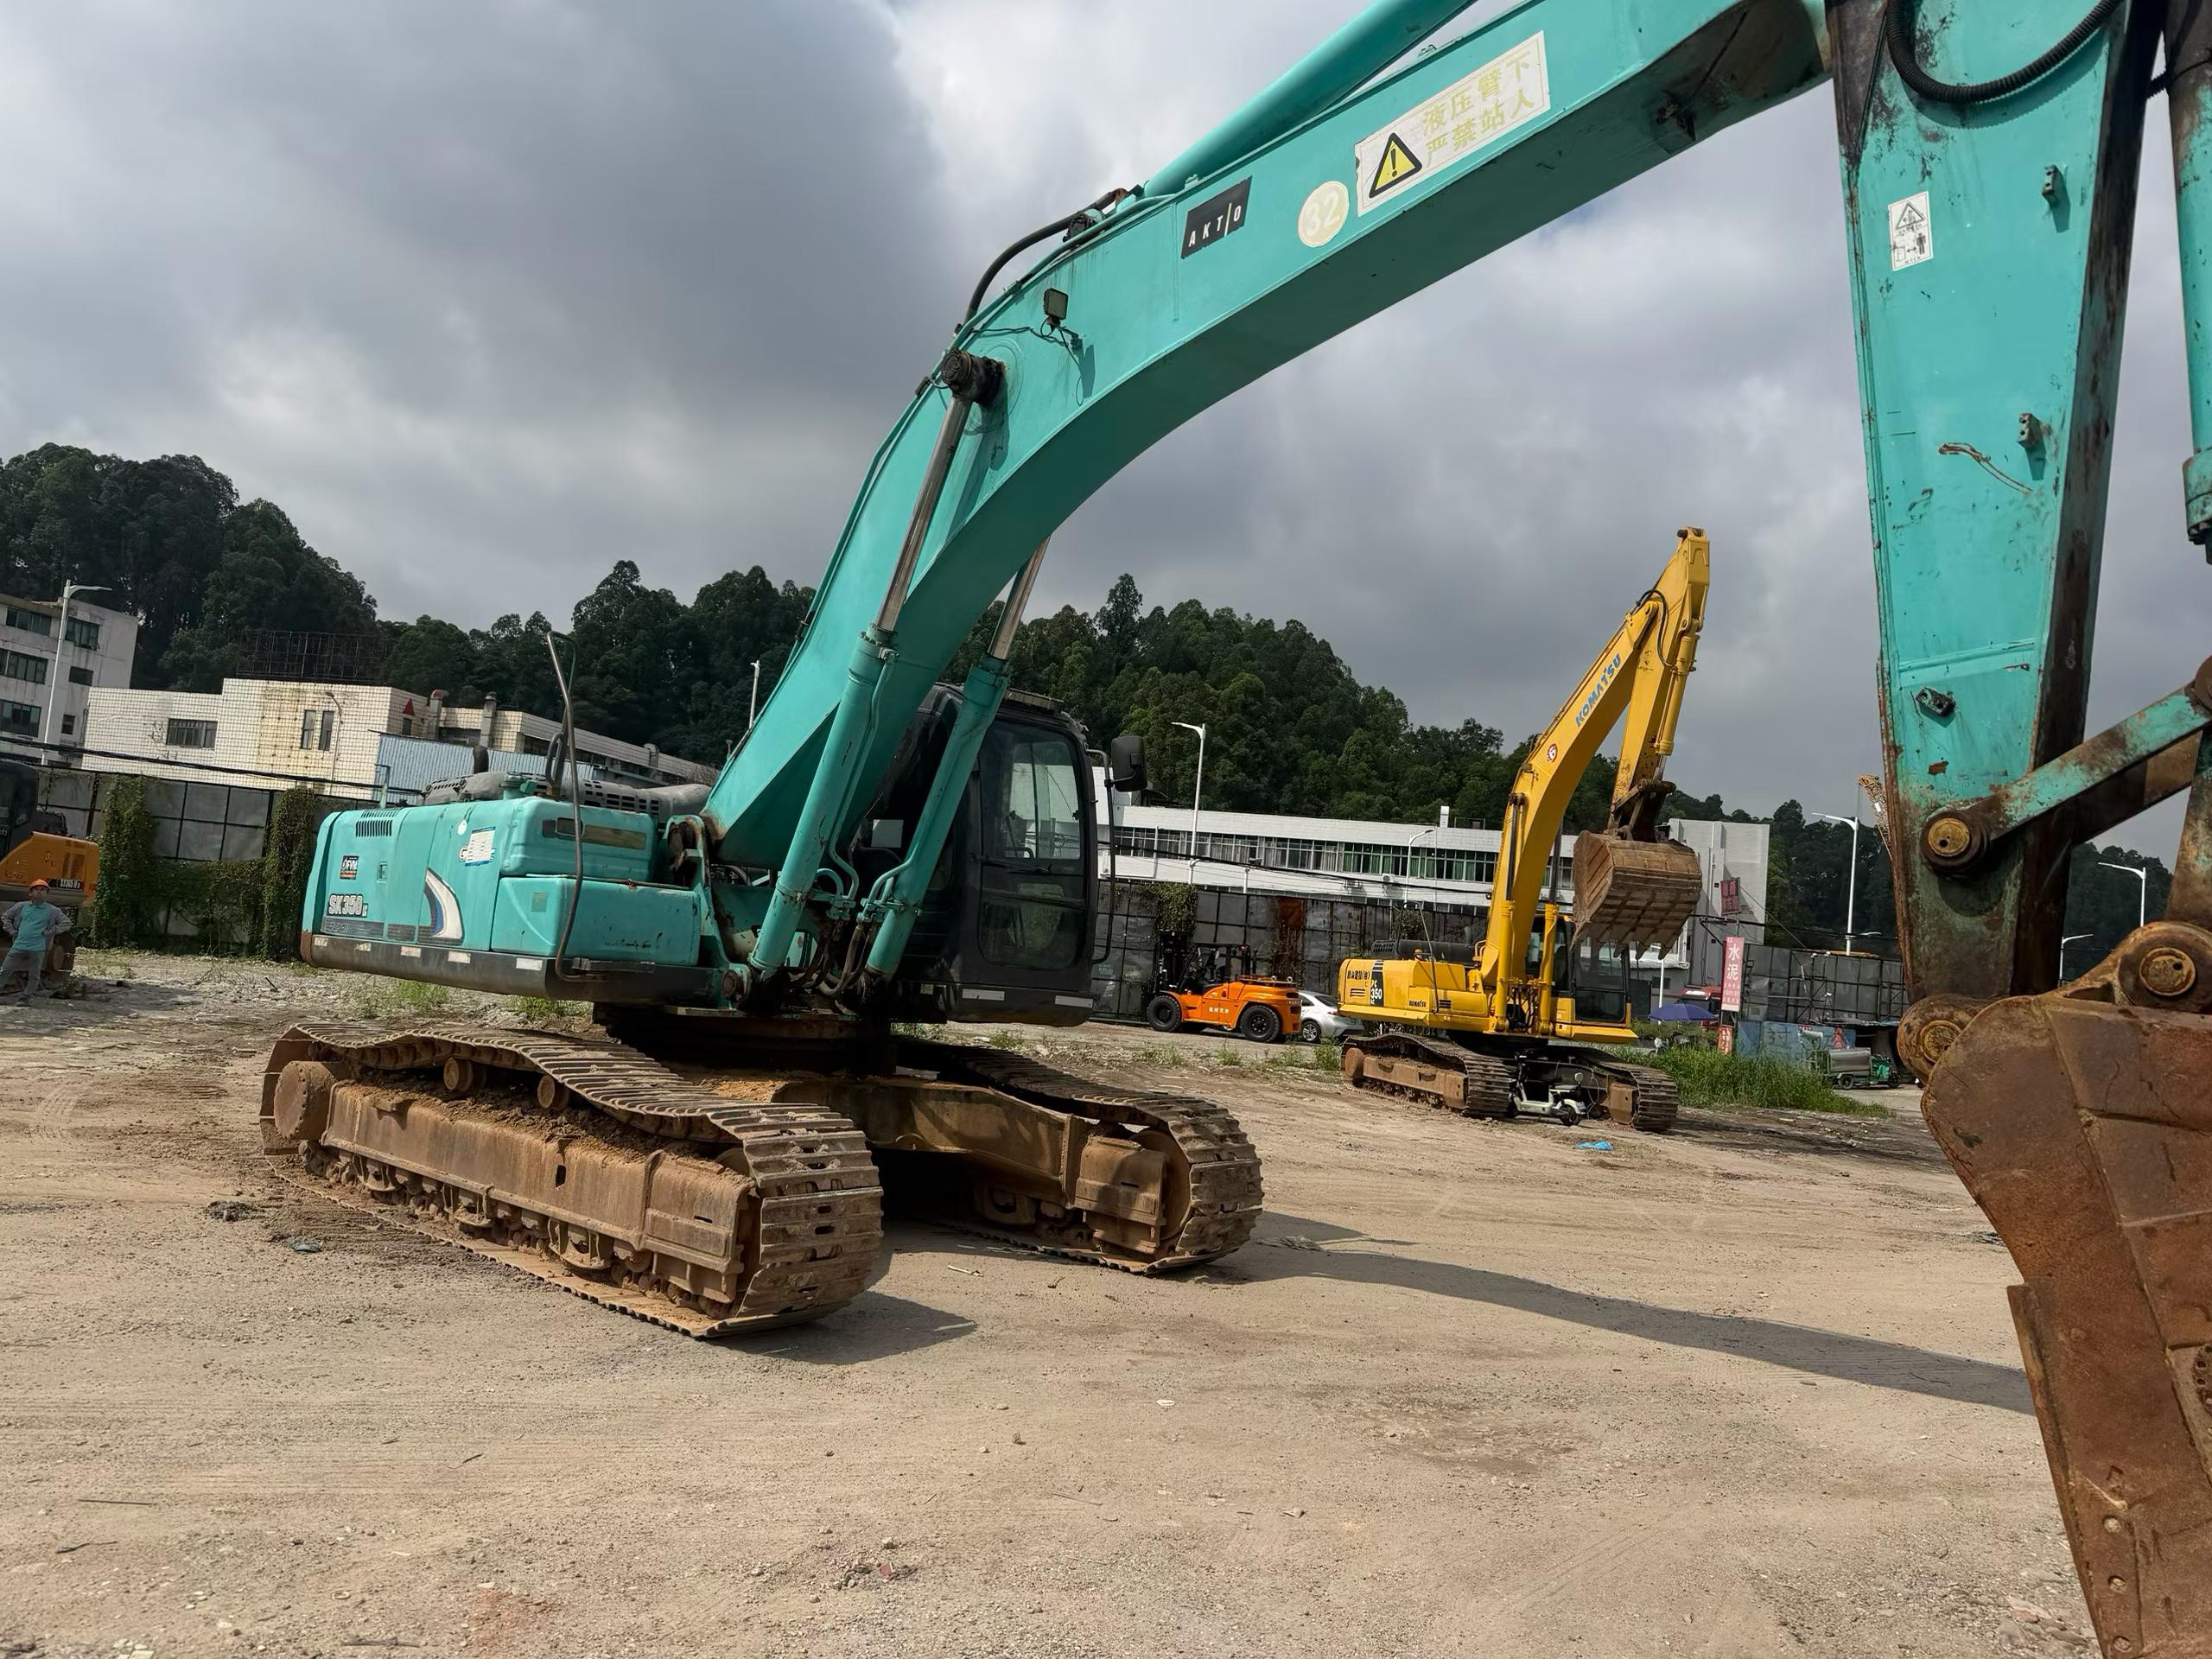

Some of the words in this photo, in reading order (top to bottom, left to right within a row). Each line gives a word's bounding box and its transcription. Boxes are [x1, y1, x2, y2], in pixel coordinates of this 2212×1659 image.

[1424, 51, 1530, 137] 液压臂下
[1426, 89, 1535, 167] 严禁站人
[1306, 190, 1341, 237] 32
[1575, 652, 1621, 727] KOMATSU
[1726, 943, 1740, 981] 水泥
[1370, 988, 1382, 1000] 350
